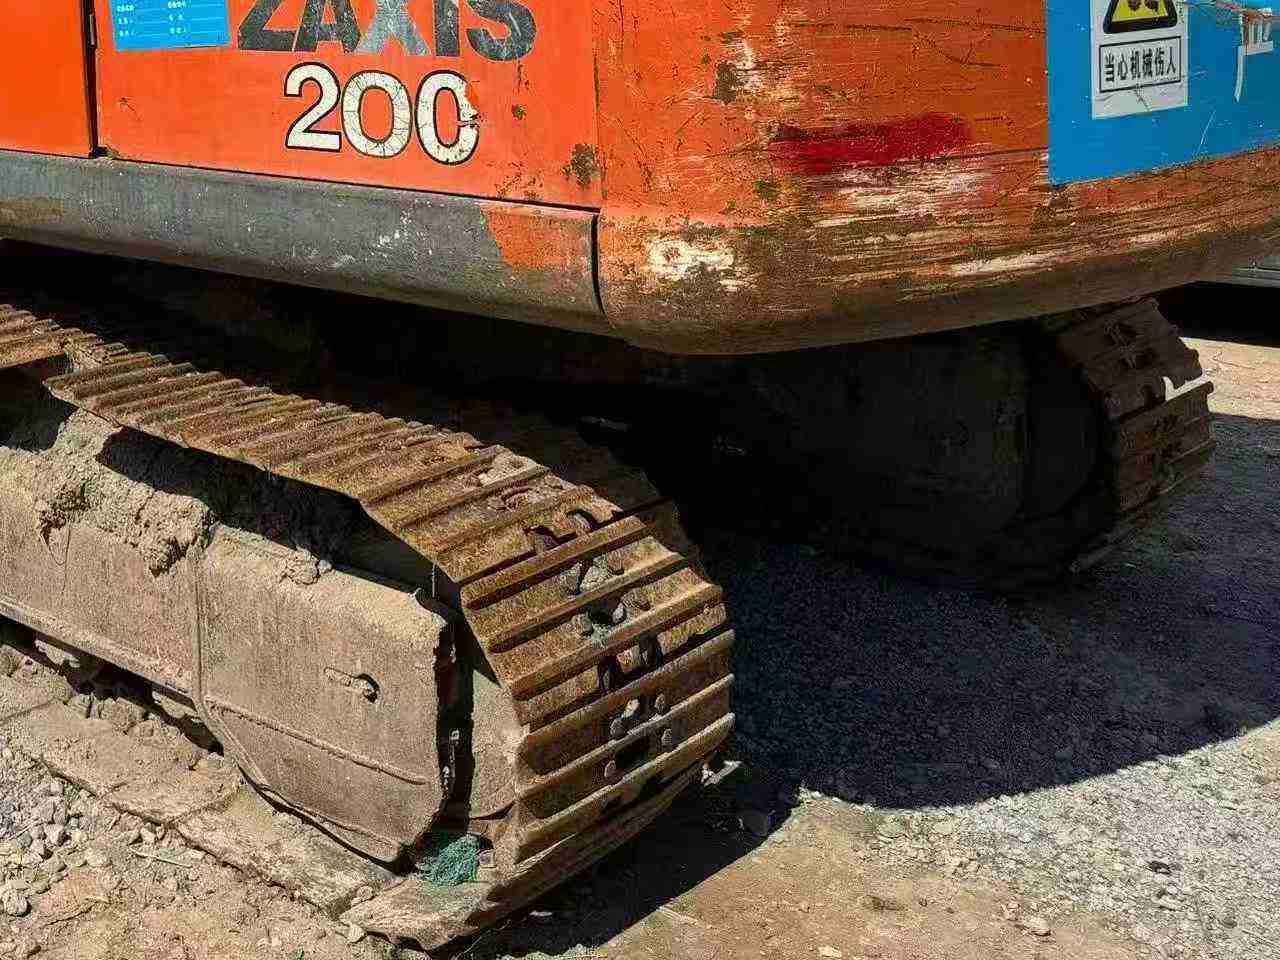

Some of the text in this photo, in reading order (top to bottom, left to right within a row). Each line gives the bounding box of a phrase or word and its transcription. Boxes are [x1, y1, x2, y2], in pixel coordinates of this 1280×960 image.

[1104, 46, 1177, 83] 当心机械伤人
[283, 61, 482, 167] 200
